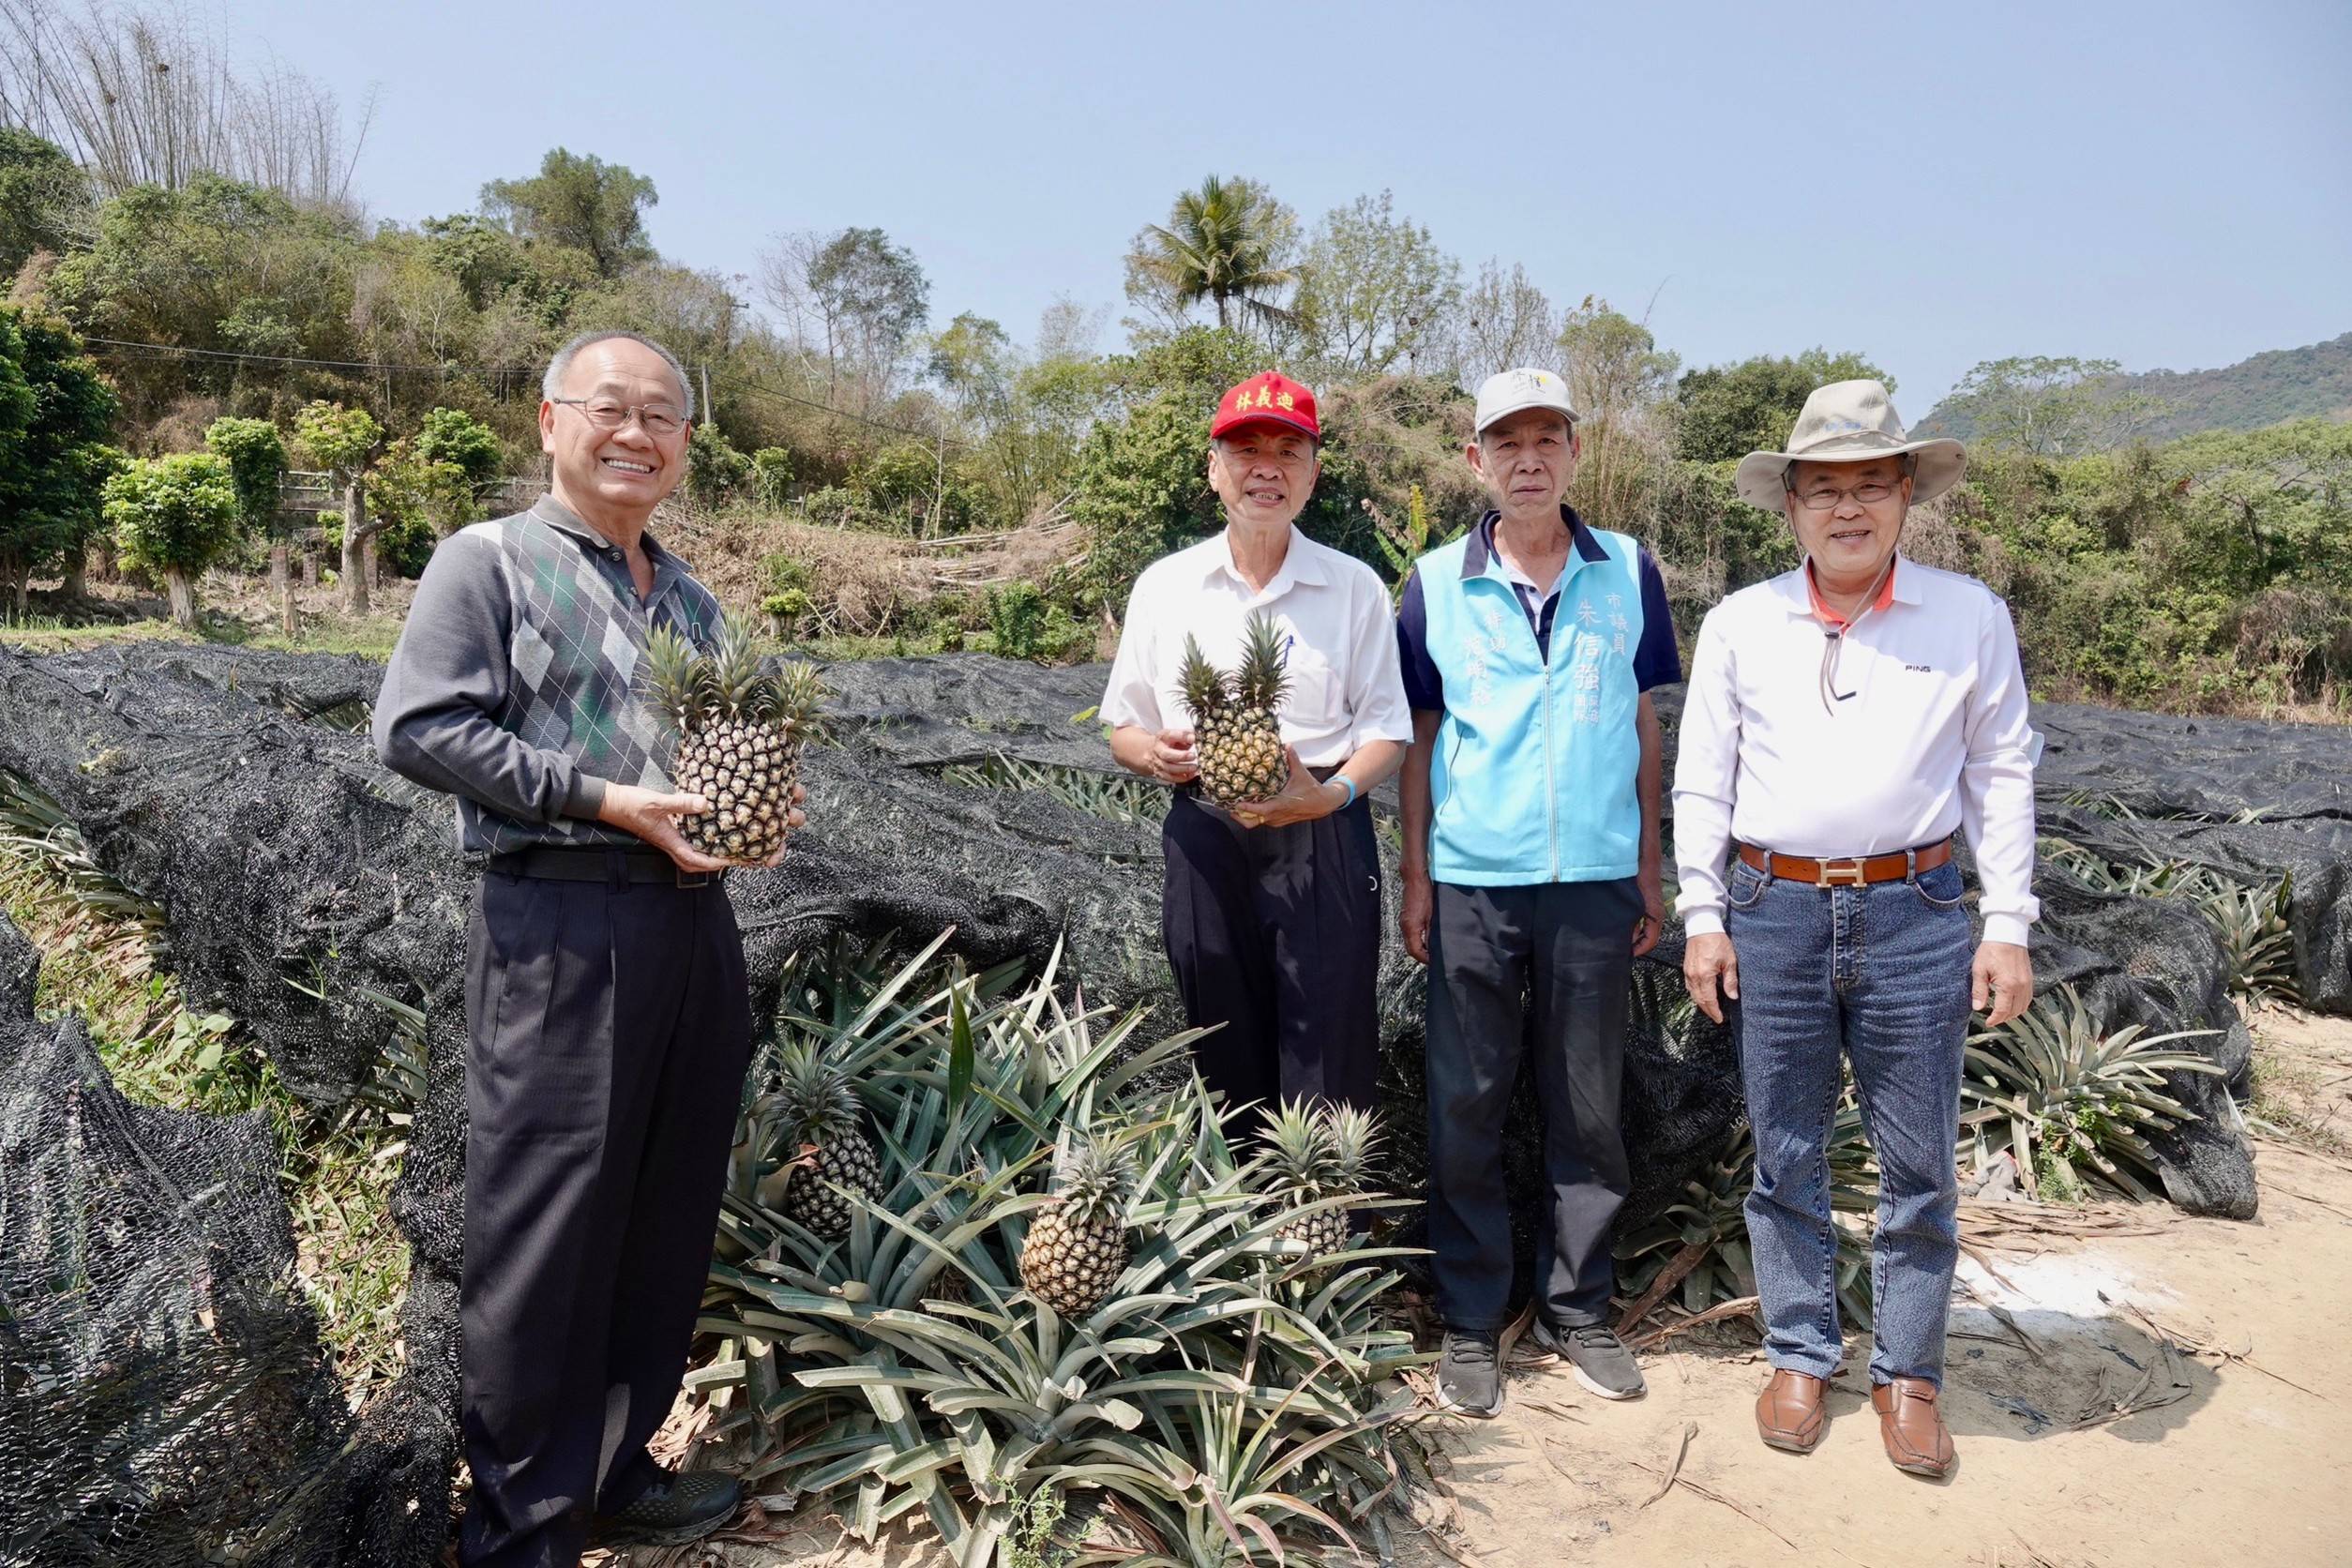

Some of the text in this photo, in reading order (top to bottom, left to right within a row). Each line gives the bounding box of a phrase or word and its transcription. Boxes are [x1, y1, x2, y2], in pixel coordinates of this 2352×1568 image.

[1575, 597, 1603, 690] 朱信強
[1905, 664, 1931, 673] PING
